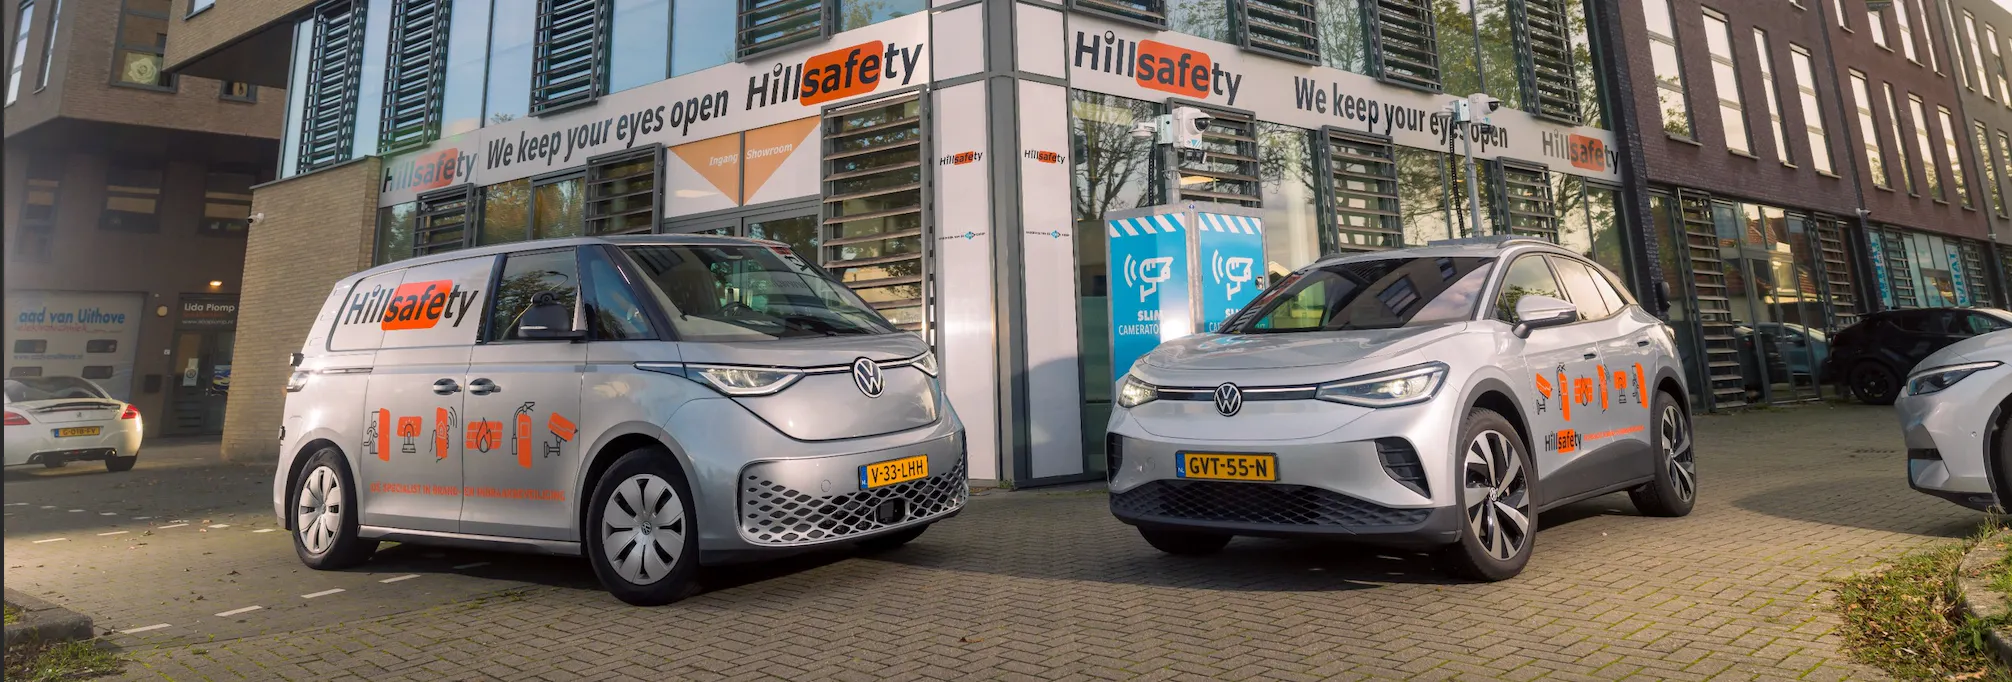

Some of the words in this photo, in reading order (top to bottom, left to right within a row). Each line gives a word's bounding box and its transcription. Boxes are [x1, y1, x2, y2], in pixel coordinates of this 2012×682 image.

[746, 43, 924, 111] Hillsafety
[1075, 30, 1242, 106] Hillsafety
[1294, 75, 1327, 114] We
[1333, 82, 1379, 133] keep
[1384, 103, 1426, 136] your
[487, 136, 513, 170] We
[517, 130, 562, 166] keep
[563, 116, 613, 163] your
[616, 105, 666, 149] eyes
[670, 89, 729, 137] open
[709, 152, 739, 167] Ingang
[746, 142, 793, 160] Showroom
[940, 151, 984, 166] Hillsafety
[1024, 149, 1066, 164] Hillsafety
[1541, 128, 1619, 175] Hillsafety
[382, 150, 477, 193] Hillsafety
[50, 312, 74, 324] van
[78, 307, 126, 324] Uithove
[184, 302, 204, 311] Lida
[206, 303, 235, 313] Plomp
[344, 283, 479, 328] Hillsafety
[1118, 324, 1161, 336] CAMERATO
[1544, 431, 1582, 452] Hillsafety
[871, 459, 924, 484] V-33-LHH
[1189, 456, 1267, 477] GVT-55-N
[370, 482, 381, 493] DE
[383, 483, 421, 494] SPECIALIST
[423, 484, 431, 495] IN
[464, 486, 474, 497] EN
